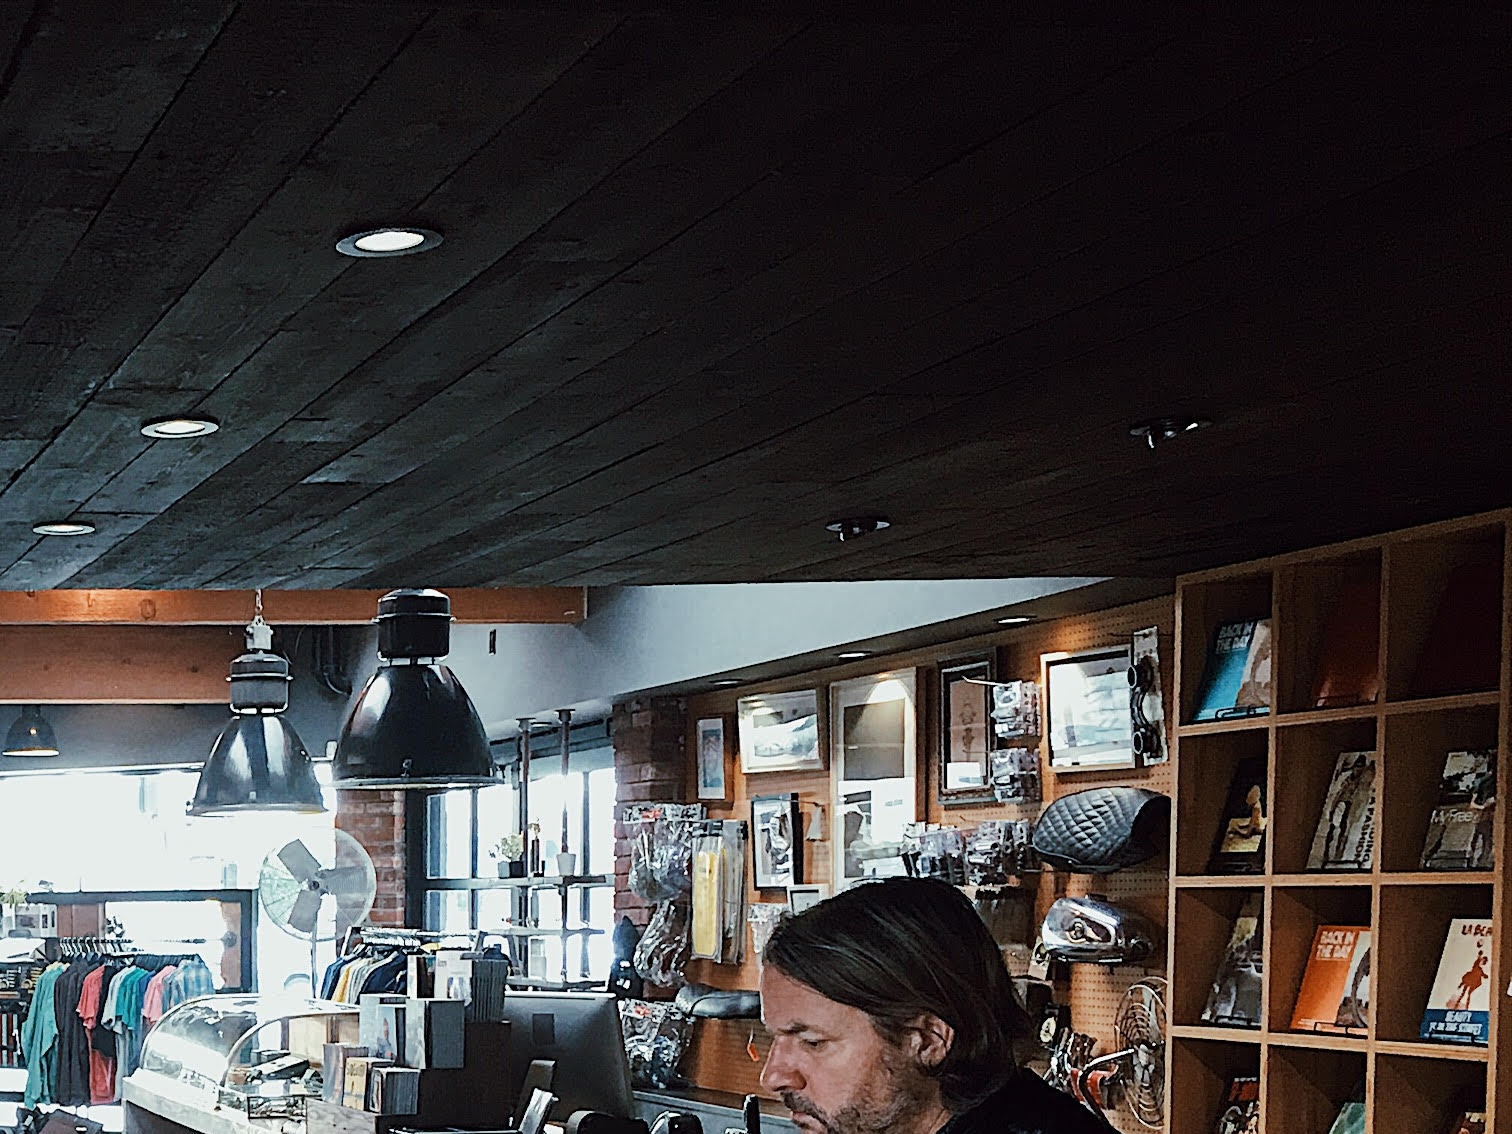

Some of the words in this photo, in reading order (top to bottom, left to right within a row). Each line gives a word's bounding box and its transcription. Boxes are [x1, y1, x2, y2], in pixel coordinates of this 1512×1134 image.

[1320, 931, 1345, 944] BACK
[1315, 945, 1334, 958] THE
[1332, 944, 1352, 958] DAY
